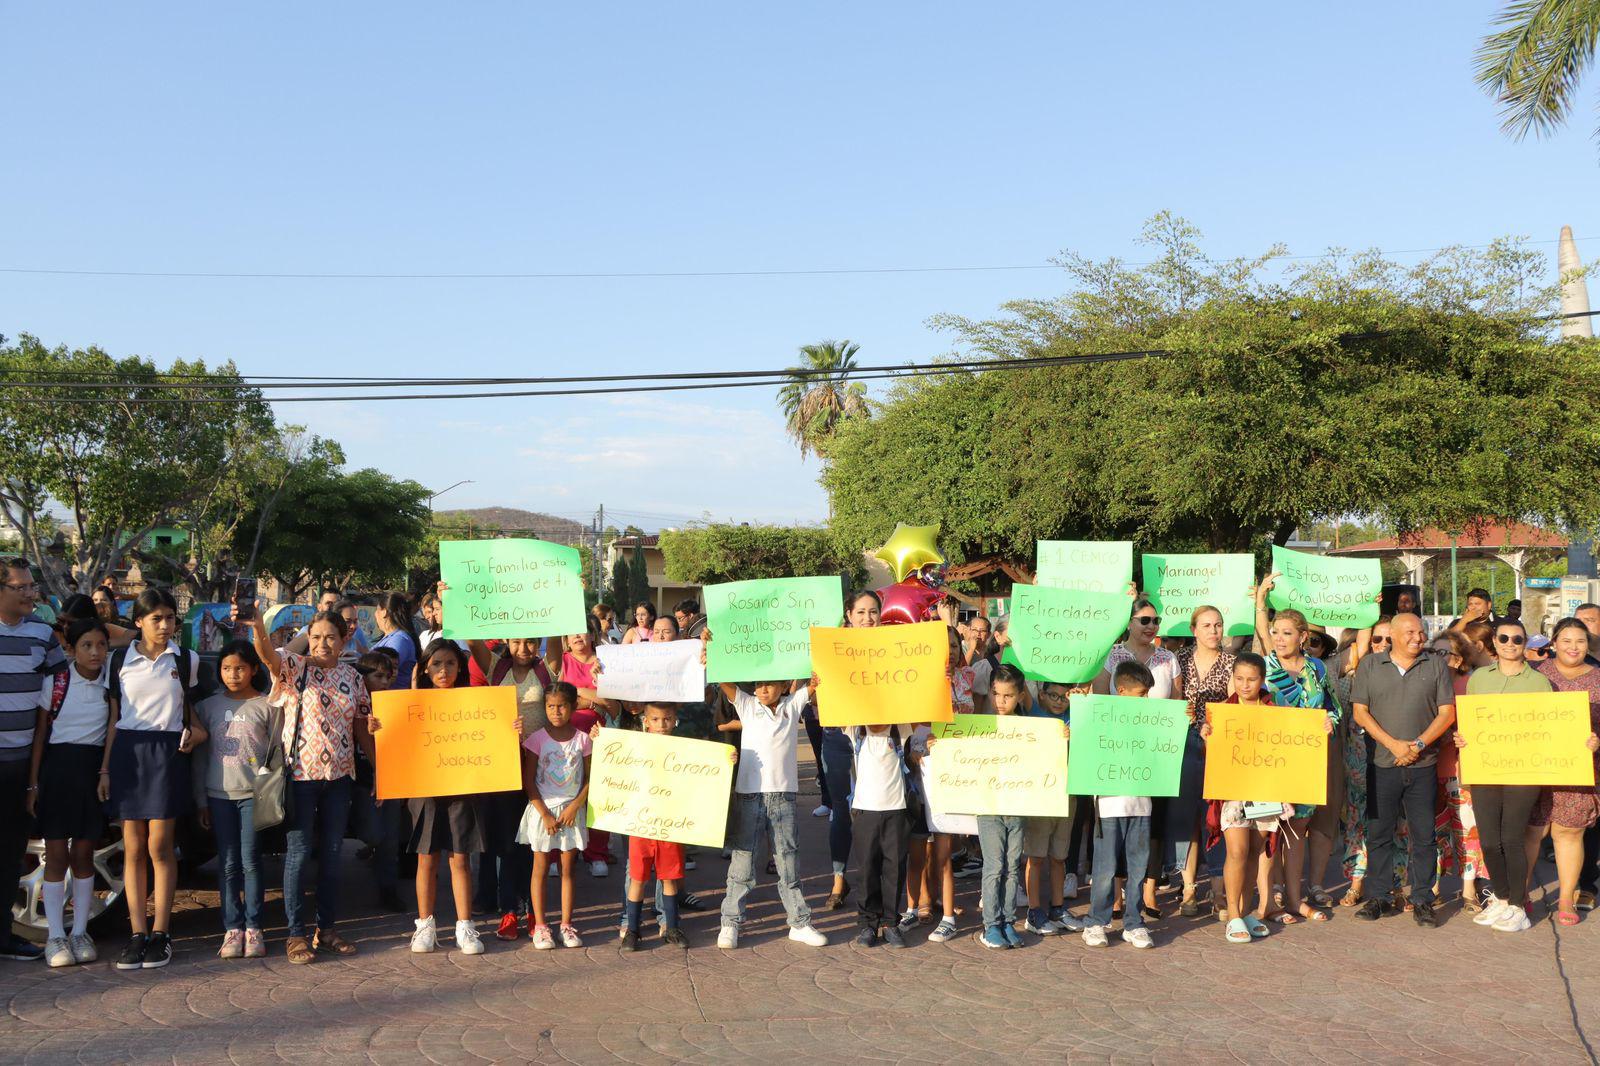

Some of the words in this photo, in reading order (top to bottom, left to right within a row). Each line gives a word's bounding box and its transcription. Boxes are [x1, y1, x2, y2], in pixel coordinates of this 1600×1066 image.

[460, 559, 481, 574] Tu
[488, 557, 538, 574] familia
[543, 556, 567, 567] esta
[1158, 560, 1222, 583] Mariangel
[1286, 561, 1330, 590] Estoy
[1337, 574, 1370, 586] muy
[464, 581, 523, 600] orgullosa
[533, 576, 549, 590] de
[555, 573, 567, 587] ti
[1160, 586, 1183, 597] Eres
[1188, 587, 1209, 597] una
[728, 591, 779, 611] Rosario
[787, 591, 815, 609] Sin
[1019, 594, 1112, 621] Felicidades
[1288, 588, 1352, 610] Orgullosa
[1355, 590, 1372, 603] de
[512, 606, 555, 621] Omar
[1312, 607, 1357, 622] Rubén
[729, 617, 792, 641] Orgullosos
[833, 642, 887, 664] Equipo
[894, 641, 932, 659] Judo
[849, 669, 919, 686] CEMCO
[407, 704, 497, 722] Felicidades
[1092, 703, 1175, 728] Felicidades
[1475, 705, 1577, 724] Felicidades
[421, 730, 486, 747] Jovenes
[1224, 718, 1322, 748] Felicidades
[1099, 735, 1146, 756] Equipo
[1151, 737, 1179, 754] Judo
[436, 752, 492, 769] Judokas
[1231, 744, 1287, 768] Rubén
[1530, 752, 1579, 769] Omar
[940, 773, 978, 787] Ruben
[1097, 763, 1152, 781] CEMCO
[625, 823, 670, 840] 2025
